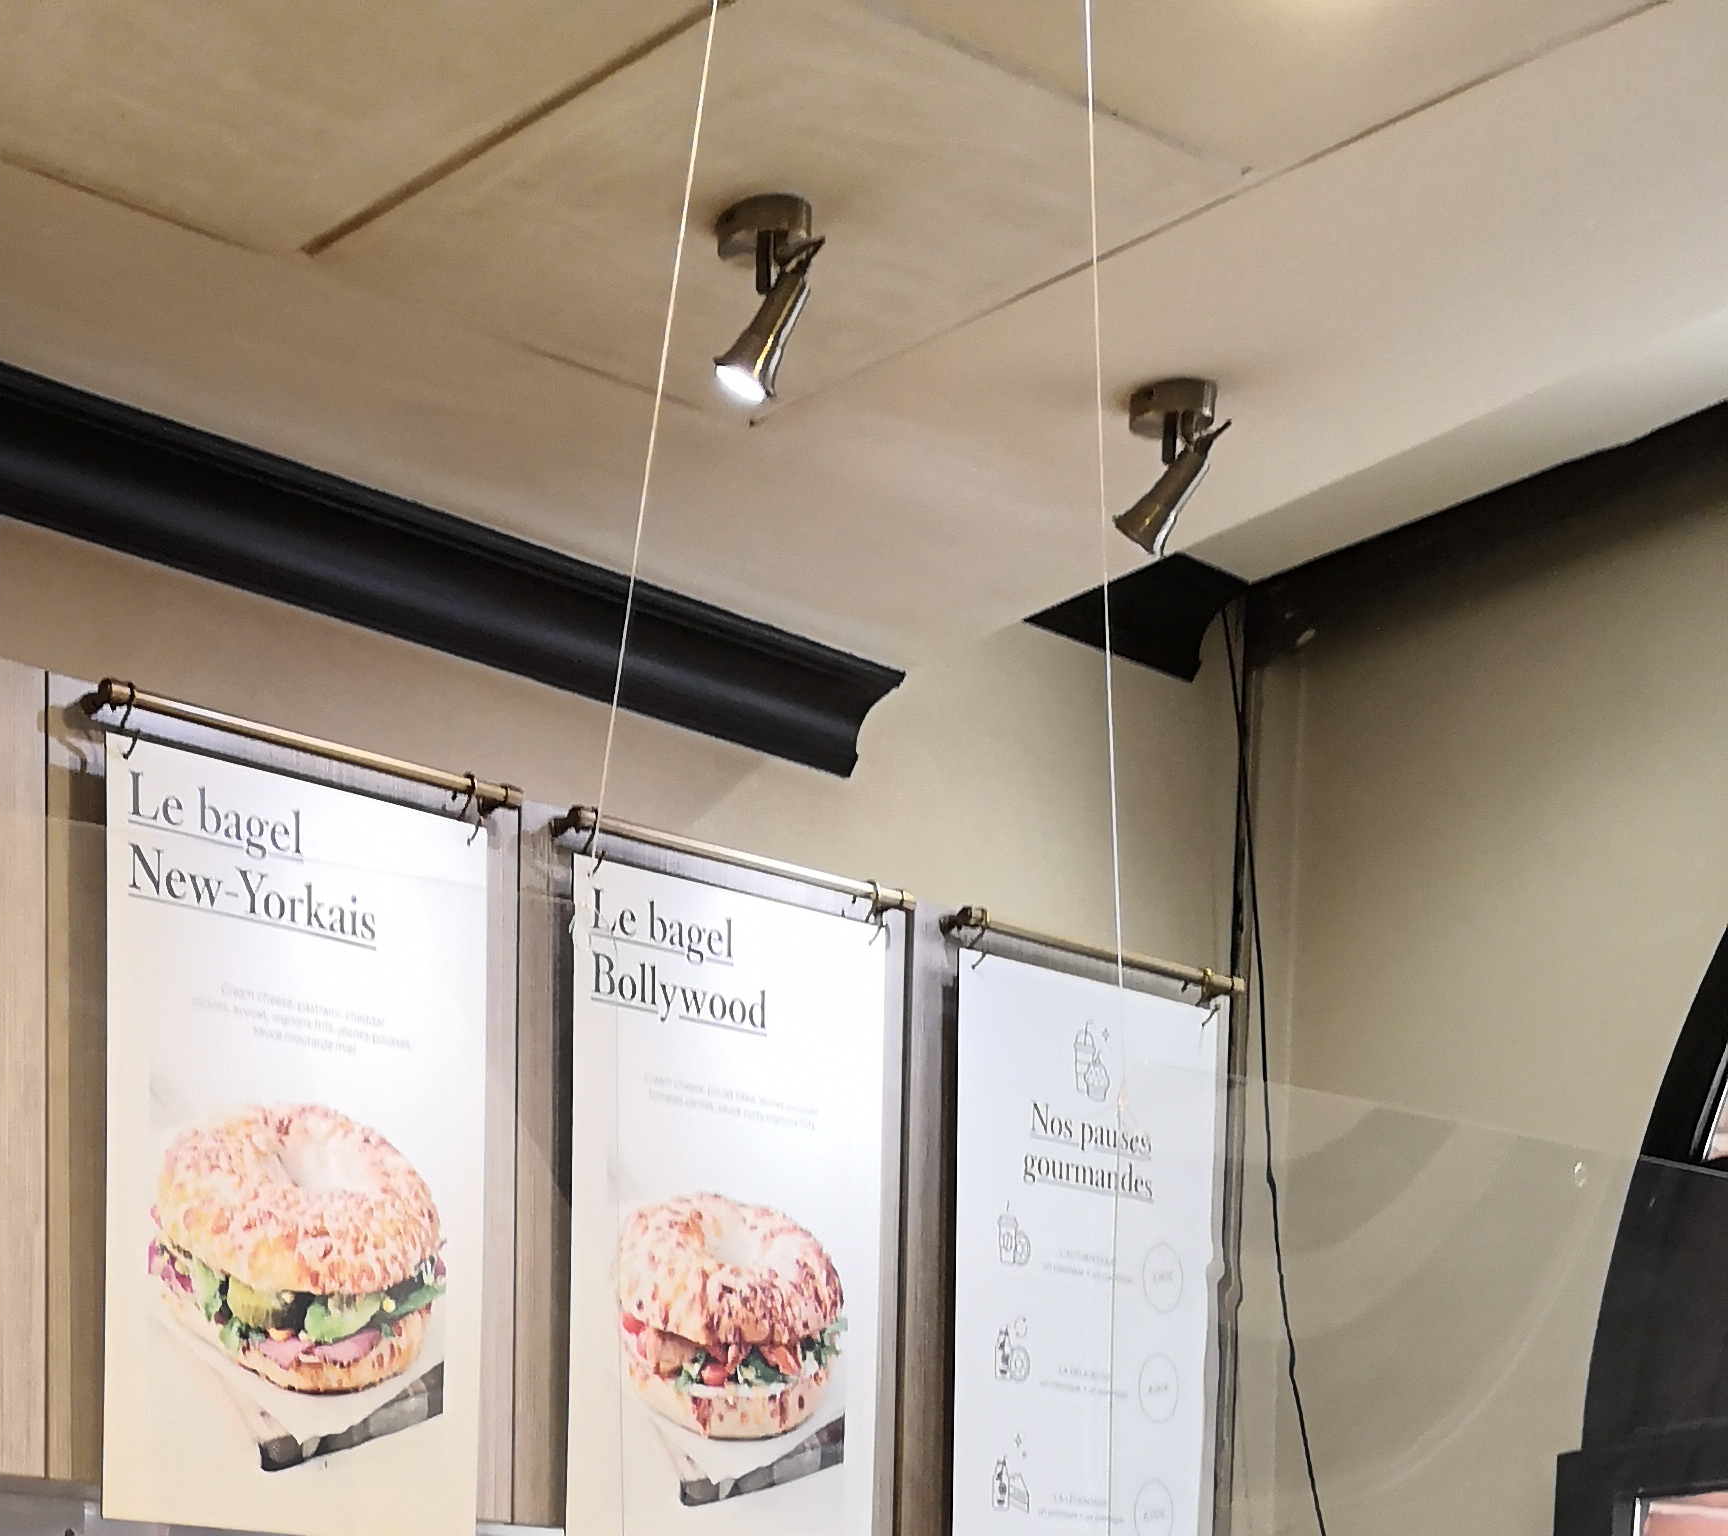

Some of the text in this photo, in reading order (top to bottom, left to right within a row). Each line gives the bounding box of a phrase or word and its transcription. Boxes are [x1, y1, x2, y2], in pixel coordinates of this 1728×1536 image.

[128, 769, 303, 860] Le bagel
[128, 841, 377, 942] New-Yorkais
[591, 887, 734, 966] Le bagel
[591, 950, 768, 1031] Bollywood
[1030, 1100, 1153, 1155] Nos pauses
[1022, 1151, 1155, 1199] gourmandes
